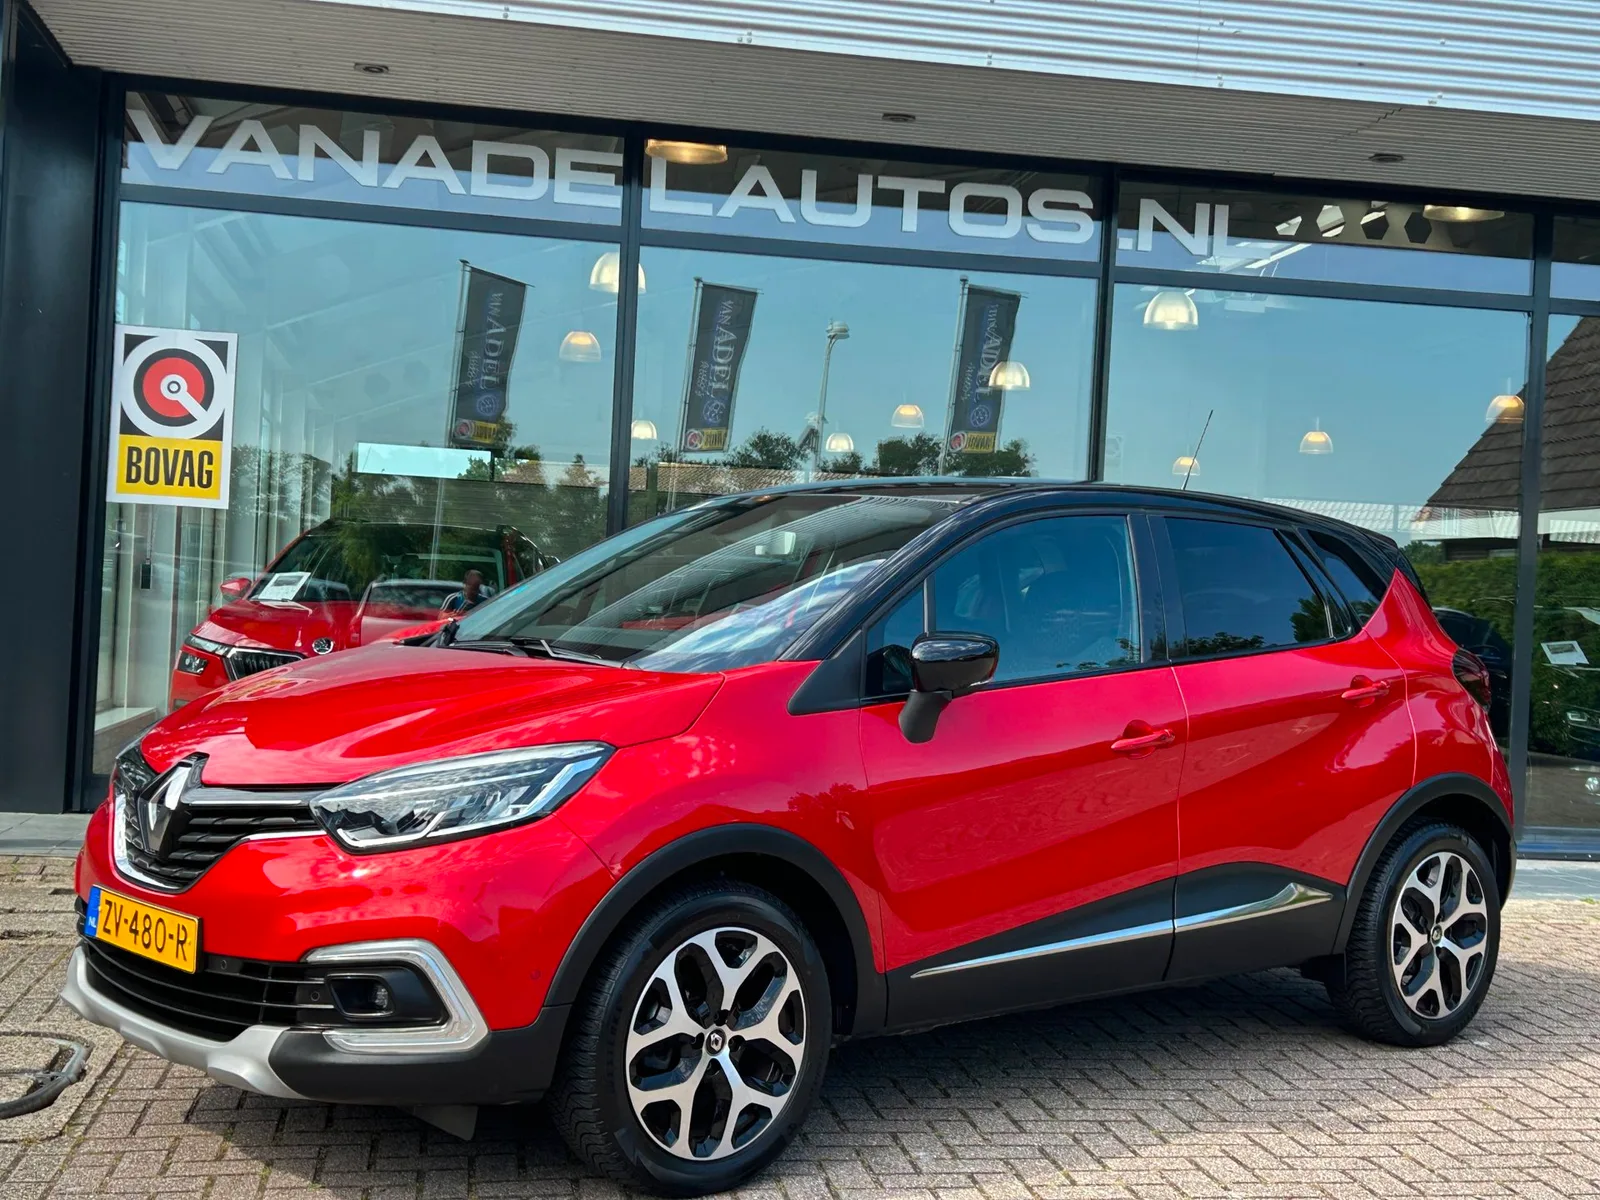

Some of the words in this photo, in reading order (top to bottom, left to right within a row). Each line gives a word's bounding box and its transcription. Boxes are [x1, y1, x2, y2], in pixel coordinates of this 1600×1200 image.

[480, 316, 507, 390] ADEL
[706, 324, 738, 398] ADEL
[126, 446, 214, 489] BOVAG
[88, 915, 97, 928] NL
[103, 899, 187, 962] ZV-480-R
